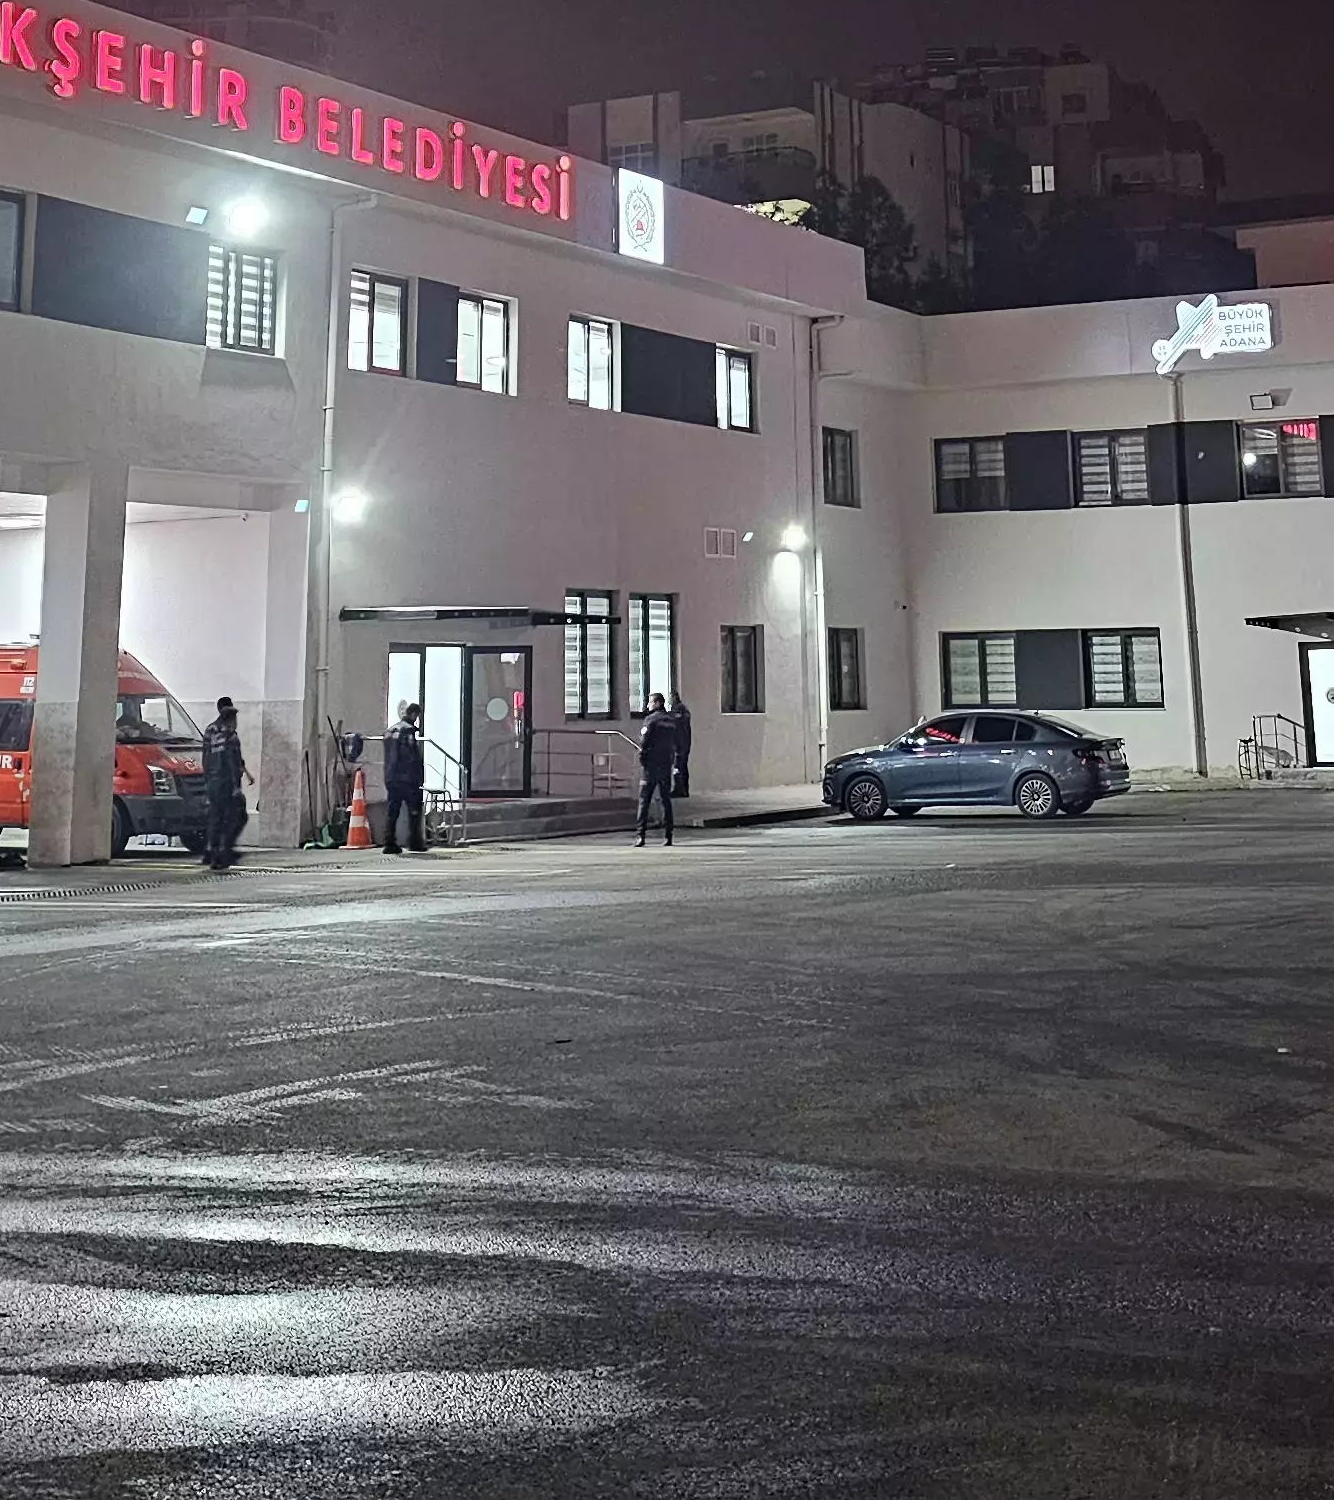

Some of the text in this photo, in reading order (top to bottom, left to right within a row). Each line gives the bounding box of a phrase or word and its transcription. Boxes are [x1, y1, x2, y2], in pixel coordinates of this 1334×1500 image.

[279, 85, 571, 221] BELEDİYESİ
[1218, 308, 1264, 321] BÜYÜK
[1224, 321, 1266, 337] ŞEHİR
[1220, 336, 1267, 347] ADANA
